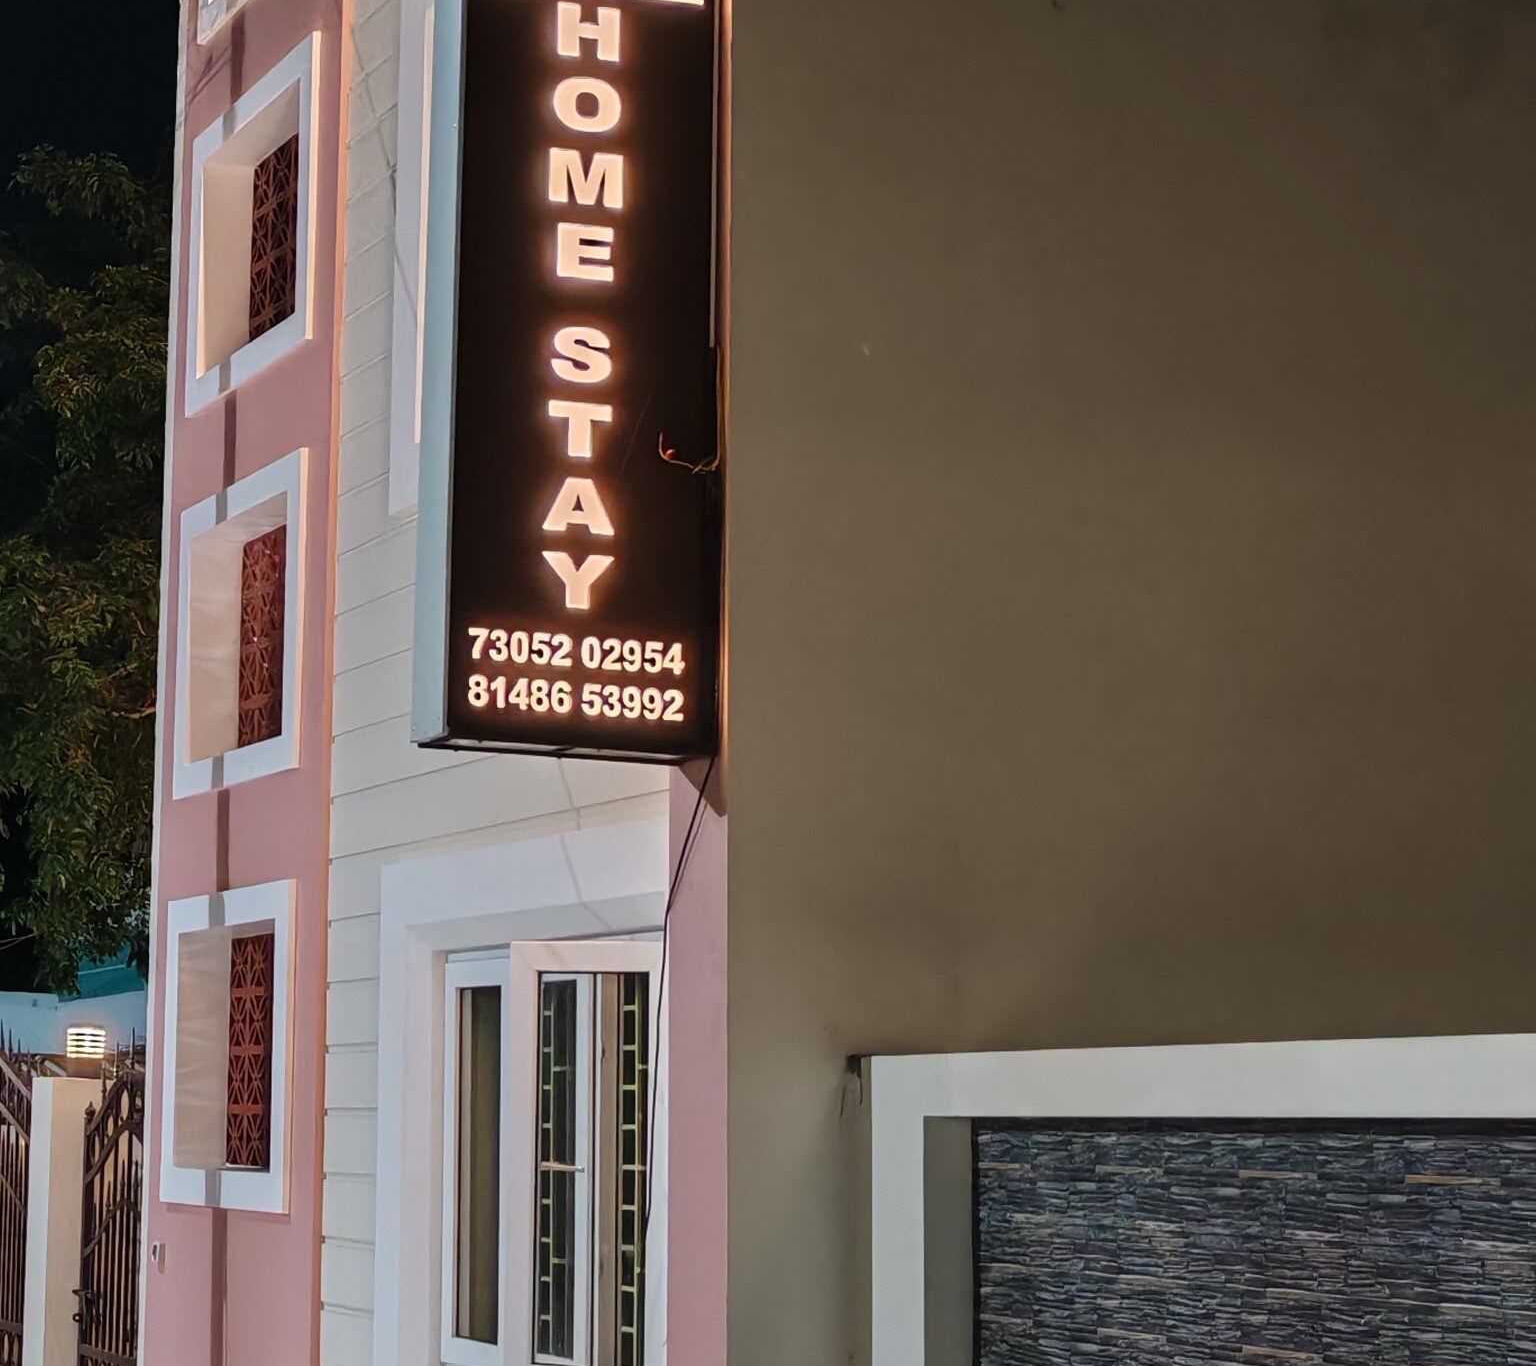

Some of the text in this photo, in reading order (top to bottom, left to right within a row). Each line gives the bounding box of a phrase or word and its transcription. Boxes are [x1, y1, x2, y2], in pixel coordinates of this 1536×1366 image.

[549, 1, 623, 281] HOME
[542, 326, 615, 609] STAY
[467, 674, 684, 722] 81486 53992
[468, 627, 685, 675] 73052 02954
